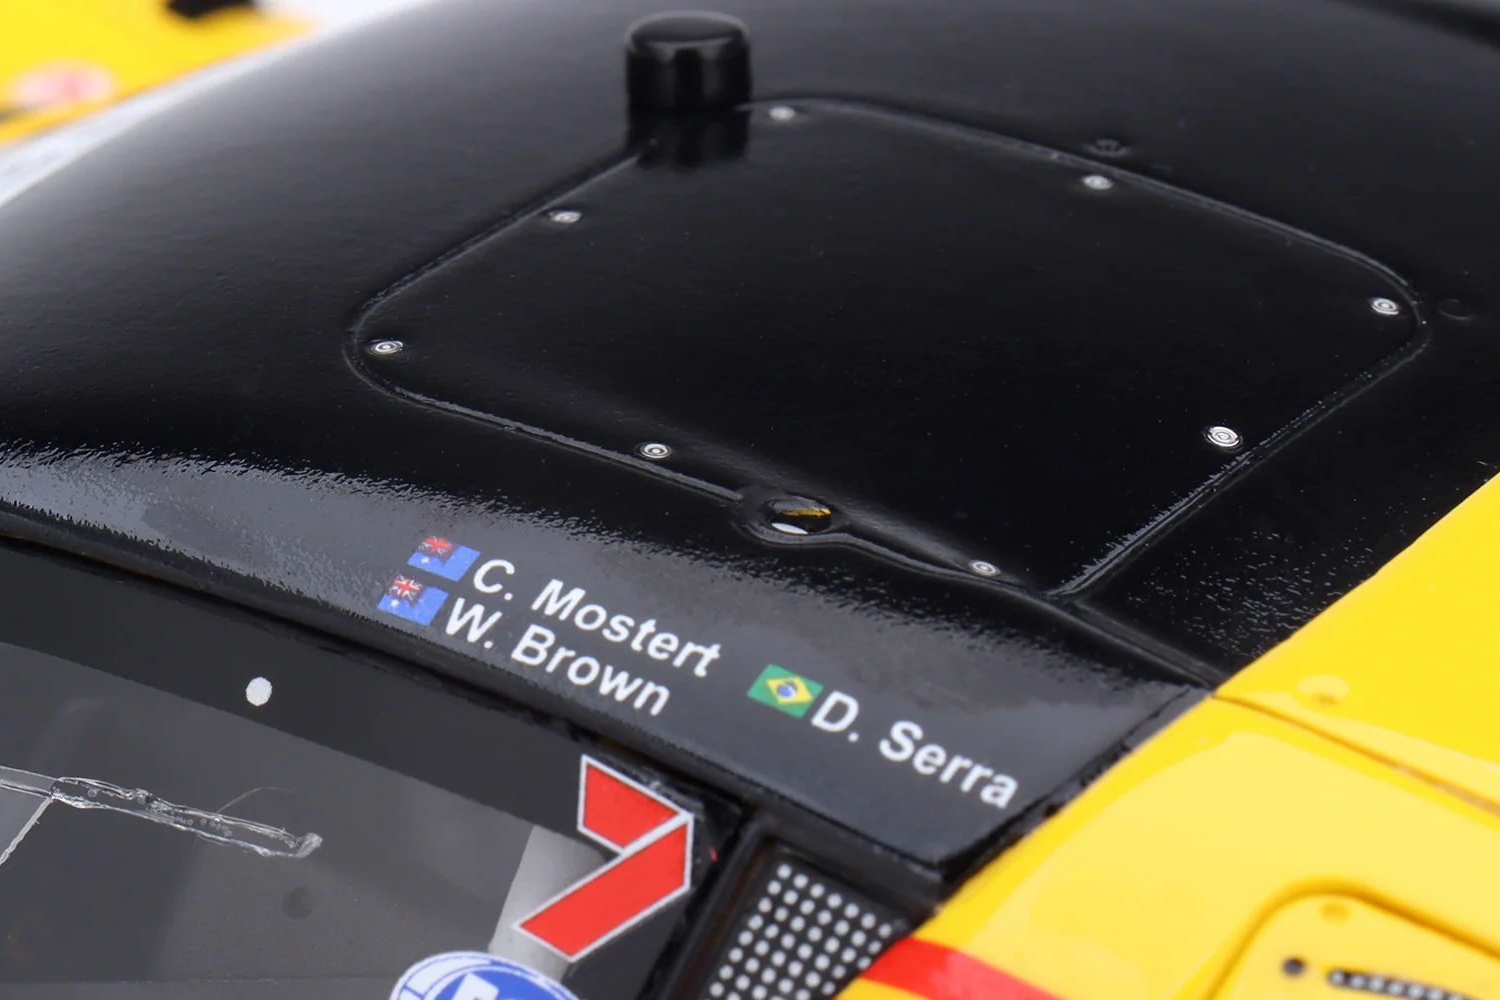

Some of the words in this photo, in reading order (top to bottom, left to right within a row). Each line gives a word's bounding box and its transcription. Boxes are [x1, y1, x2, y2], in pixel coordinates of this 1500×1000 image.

[443, 595, 503, 650] W.
[510, 622, 672, 718] Brown
[471, 557, 517, 602] C.
[530, 577, 722, 678] Mostert
[809, 689, 861, 743] D.
[877, 719, 1020, 810] Serra
